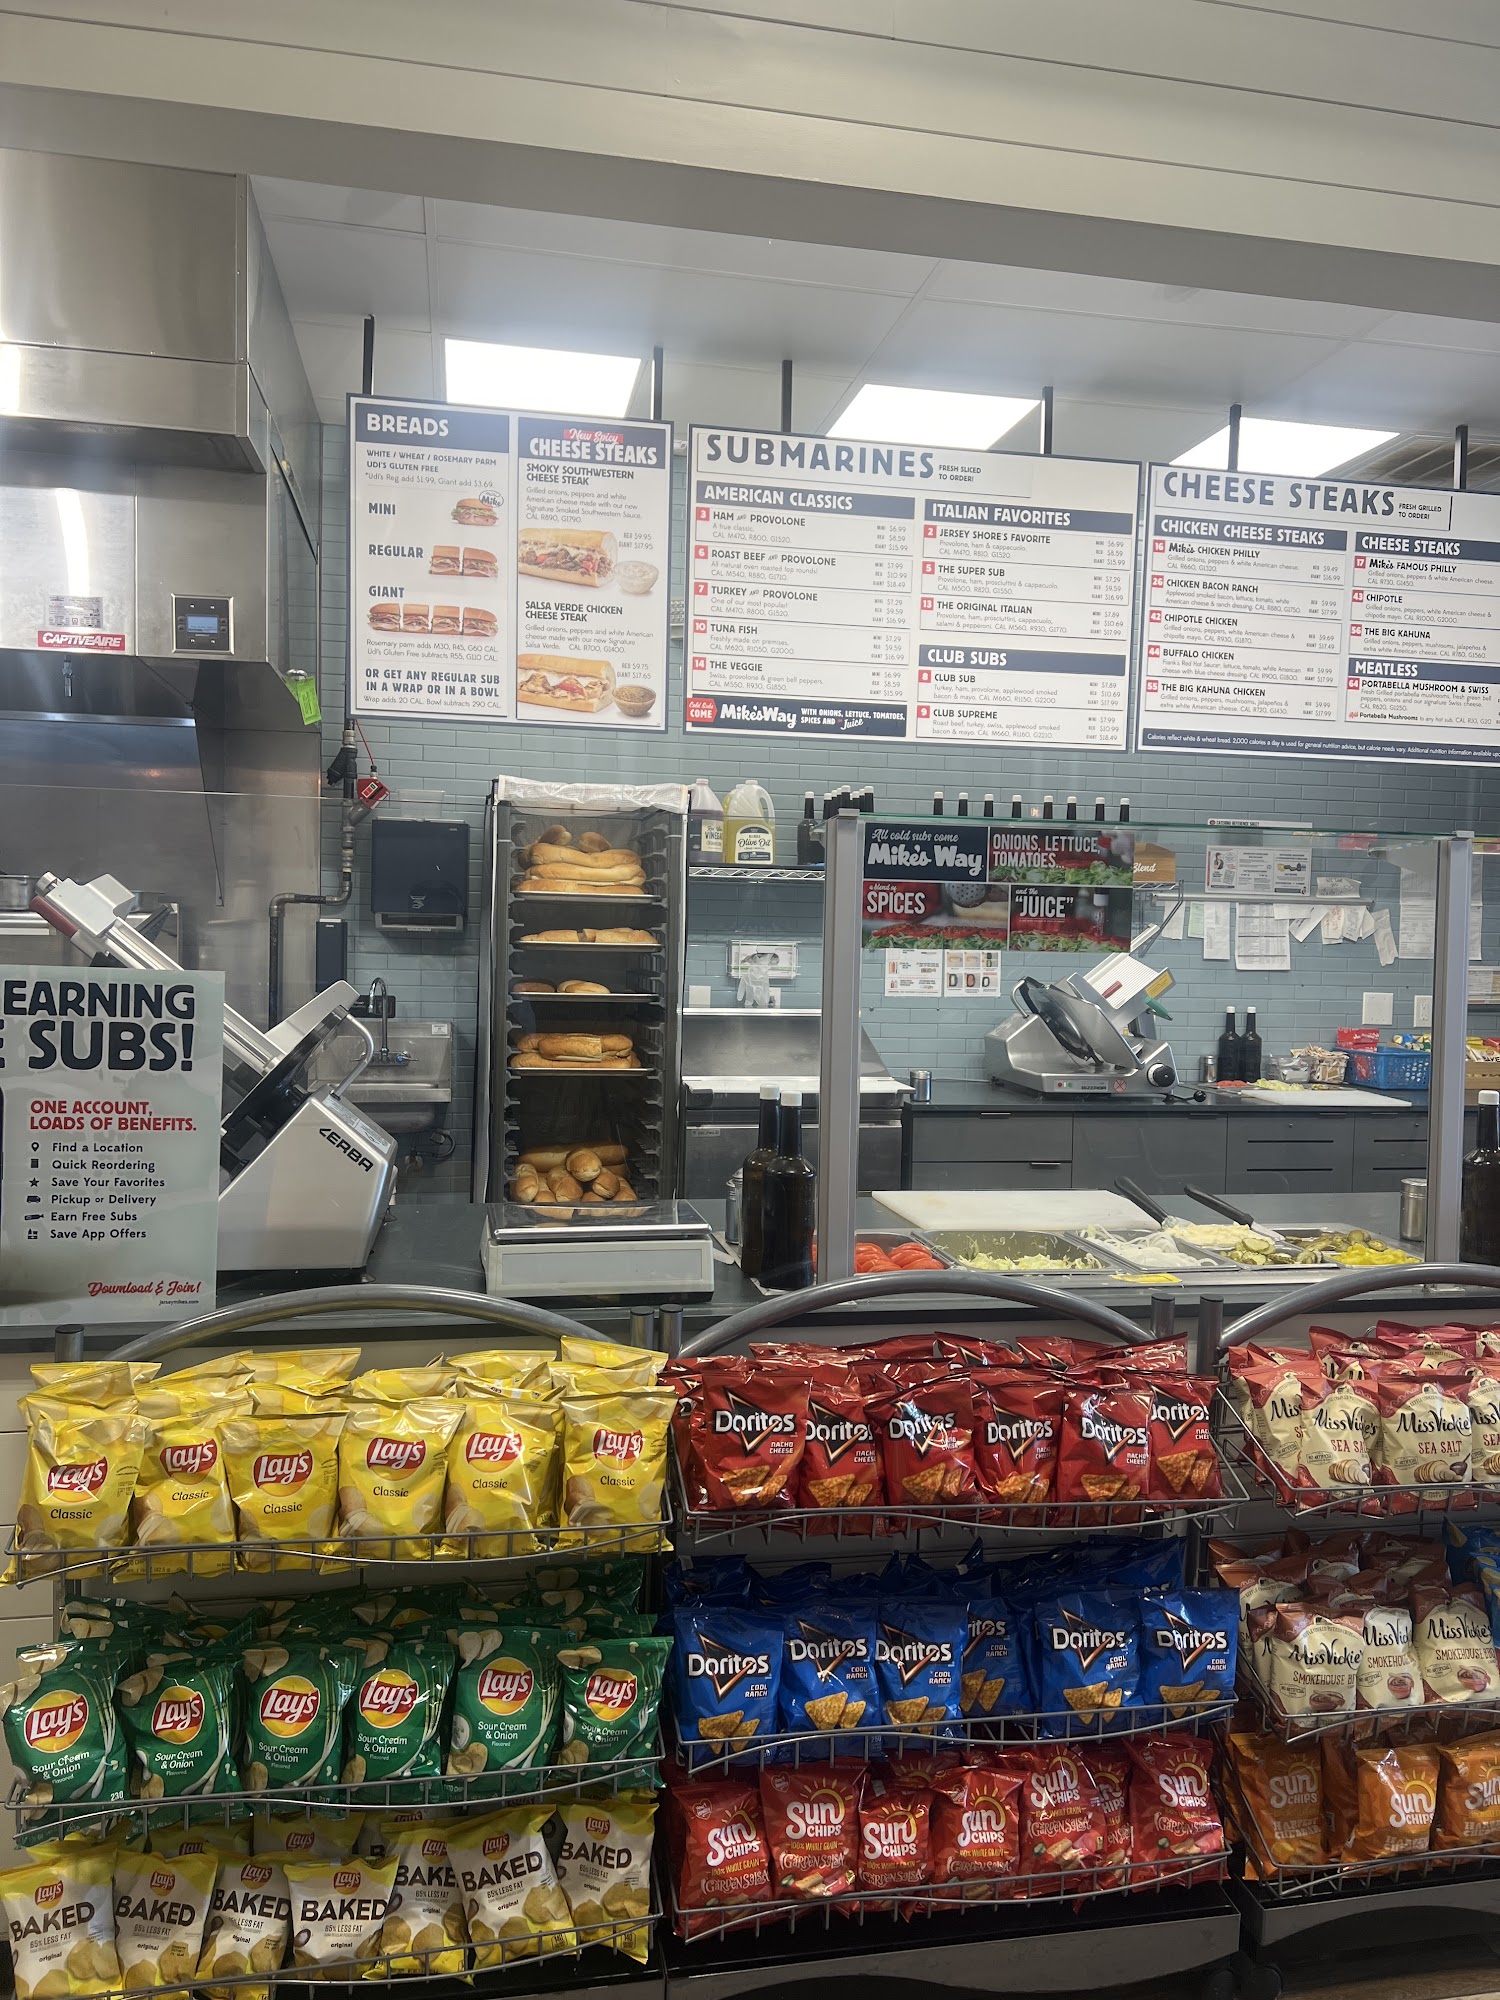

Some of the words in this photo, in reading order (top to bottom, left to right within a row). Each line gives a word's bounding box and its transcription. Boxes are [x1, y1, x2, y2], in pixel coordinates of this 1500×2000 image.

[367, 413, 449, 437] BREADS
[569, 429, 593, 441] New
[595, 430, 618, 444] Spicy
[530, 437, 591, 459] CHEESE
[596, 442, 657, 465] STEAKS
[707, 434, 933, 479] SUBMARINES
[366, 461, 386, 469] UDI'S
[389, 462, 417, 472] GLUTEN
[420, 464, 439, 473] FREE
[527, 463, 559, 473] SMOKY
[562, 466, 634, 479] SOUTHWESTERN
[939, 465, 959, 473] FRESH
[527, 473, 558, 483] CHEESE
[561, 476, 589, 486] STEAK
[939, 473, 948, 481] TO
[950, 474, 974, 482] ORDER!
[704, 486, 784, 504] AMERICAN
[790, 493, 852, 510] CLASSICS
[1164, 472, 1274, 506] CHEESE
[1289, 482, 1394, 516] STEAKS
[368, 503, 396, 515] MINI
[933, 503, 989, 521] ITALIAN
[994, 509, 1070, 526] FAVORITES
[1399, 503, 1416, 511] FRESH
[1418, 504, 1442, 512] GRILLED
[700, 510, 706, 518] 3
[714, 512, 734, 520] HAM
[750, 514, 805, 526] PROVOLONE
[940, 529, 970, 538] JERSEY
[972, 531, 1008, 541] SHORE'S
[1010, 533, 1050, 543] FAVORITE
[1161, 519, 1219, 536] CHICKEN
[1223, 525, 1272, 540] CHEESE
[1277, 529, 1324, 545] STEAKS
[368, 544, 424, 558] REGULAR
[1362, 536, 1409, 552] CHEESE
[1414, 539, 1460, 555] STEAKS
[1369, 559, 1394, 569] Mike's
[1396, 562, 1429, 571] FAMOUS
[1431, 564, 1456, 573] PHILLY
[368, 586, 405, 598] GIANT
[1153, 578, 1162, 586] 26
[1167, 578, 1200, 589] CHICKEN
[1202, 581, 1230, 591] BACON
[1232, 584, 1258, 593] RANCH
[1366, 594, 1403, 603] CHIPOTLE
[525, 601, 552, 611] SALSA
[554, 603, 583, 613] VERDE
[586, 604, 623, 615] CHICKEN
[937, 601, 954, 610] THE
[957, 603, 998, 612] ORIGINAL
[1001, 605, 1032, 614] ITALIAN
[526, 611, 558, 620] CHEESE
[561, 612, 587, 622] STEAK
[695, 622, 706, 631] 10
[710, 624, 736, 633] TUNA
[738, 626, 758, 634] FISH
[42, 632, 122, 648] CAPTIVEAIRE
[928, 649, 964, 664] CLUB
[970, 652, 1007, 666] SUBS
[710, 661, 727, 670] THE
[730, 662, 762, 671] VEGGIE
[1355, 661, 1418, 677] MEATLESS
[1362, 680, 1410, 690] PORTABELLA
[1412, 683, 1458, 692] MUSHROOM
[738, 838, 757, 847] Olive
[758, 839, 771, 847] Oil
[872, 829, 888, 841] All
[891, 830, 908, 842] cold
[910, 830, 932, 842] subs
[934, 832, 959, 843] come
[993, 834, 1042, 852] ONIONS,
[1044, 836, 1100, 854] LETTUCE,
[867, 843, 932, 867] Mike's
[933, 845, 984, 877] Way
[993, 851, 1064, 870] TOMATOES...
[867, 892, 925, 914] SPICES
[4, 980, 195, 1019] EARNING
[29, 1020, 194, 1072] SUBS!
[30, 1101, 67, 1115] ONE
[72, 1101, 153, 1117] ACCOUNT,
[30, 1117, 84, 1130] LOADS
[90, 1117, 112, 1131] OF
[118, 1118, 197, 1132] BENEFITS.
[52, 1142, 77, 1152] Find
[82, 1145, 89, 1153] a
[94, 1142, 143, 1153] Location
[52, 1159, 87, 1170] Quick
[92, 1160, 155, 1173] Reordering
[51, 1177, 79, 1187] Save
[84, 1177, 110, 1187] Your
[115, 1177, 165, 1188] Favorites
[88, 1281, 153, 1296] Download
[155, 1280, 163, 1295] &
[168, 1280, 201, 1297] Join!
[715, 1410, 795, 1433] Doritos
[1082, 1418, 1146, 1445] Doritos
[370, 1437, 424, 1469] Lay's
[1418, 1442, 1437, 1454] SEA
[1440, 1441, 1462, 1454] SALT
[257, 1453, 310, 1485] Lay's
[599, 1476, 635, 1487] Classic
[263, 1502, 303, 1515] Classic
[1427, 1618, 1460, 1640] Miss
[1455, 1613, 1492, 1644] Vickie's
[1157, 1630, 1227, 1650] Doritos
[1436, 1648, 1483, 1661] SMOKEHOUSE
[688, 1653, 769, 1677] Doritos
[481, 1671, 530, 1703] Lay's
[261, 1688, 317, 1723] Lay's
[478, 1721, 498, 1730] Sour
[500, 1722, 527, 1732] Cream
[486, 1730, 492, 1739] &
[494, 1730, 518, 1740] Onion
[1159, 1774, 1206, 1808] Sun
[1179, 1796, 1206, 1808] CHIPS
[786, 1800, 846, 1839] Sun
[806, 1824, 842, 1836] CHIPS
[559, 1842, 632, 1869] BAKED
[462, 1850, 543, 1892] BAKED
[499, 1884, 513, 1896] LESS
[513, 1881, 524, 1892] FAT
[116, 1896, 196, 1927] BAKED
[497, 1900, 519, 1911] original
